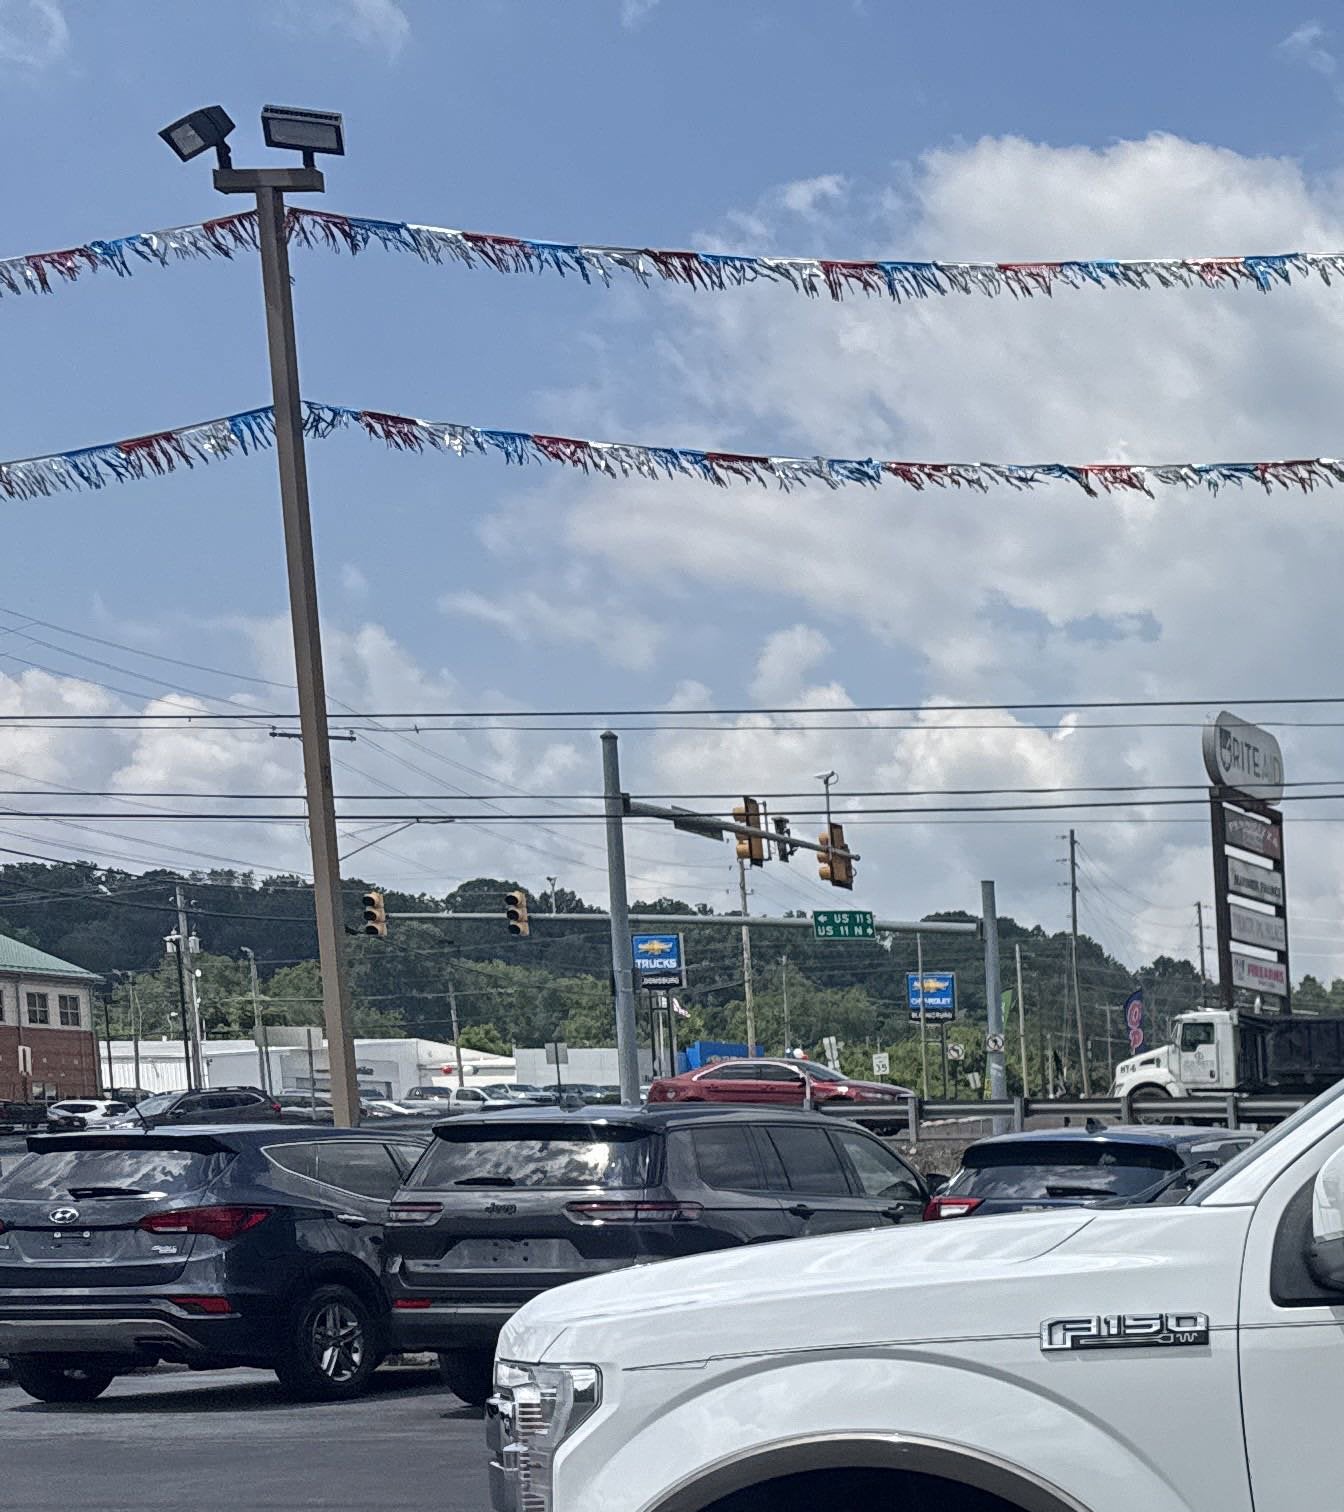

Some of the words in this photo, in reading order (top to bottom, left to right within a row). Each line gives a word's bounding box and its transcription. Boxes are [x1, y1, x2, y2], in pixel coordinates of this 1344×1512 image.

[1233, 736, 1260, 778] RITE
[833, 913, 849, 924] US
[856, 913, 864, 924] 11
[817, 925, 833, 936] US
[840, 925, 849, 936] 11
[854, 925, 863, 936] N
[635, 958, 677, 969] TRUCKS
